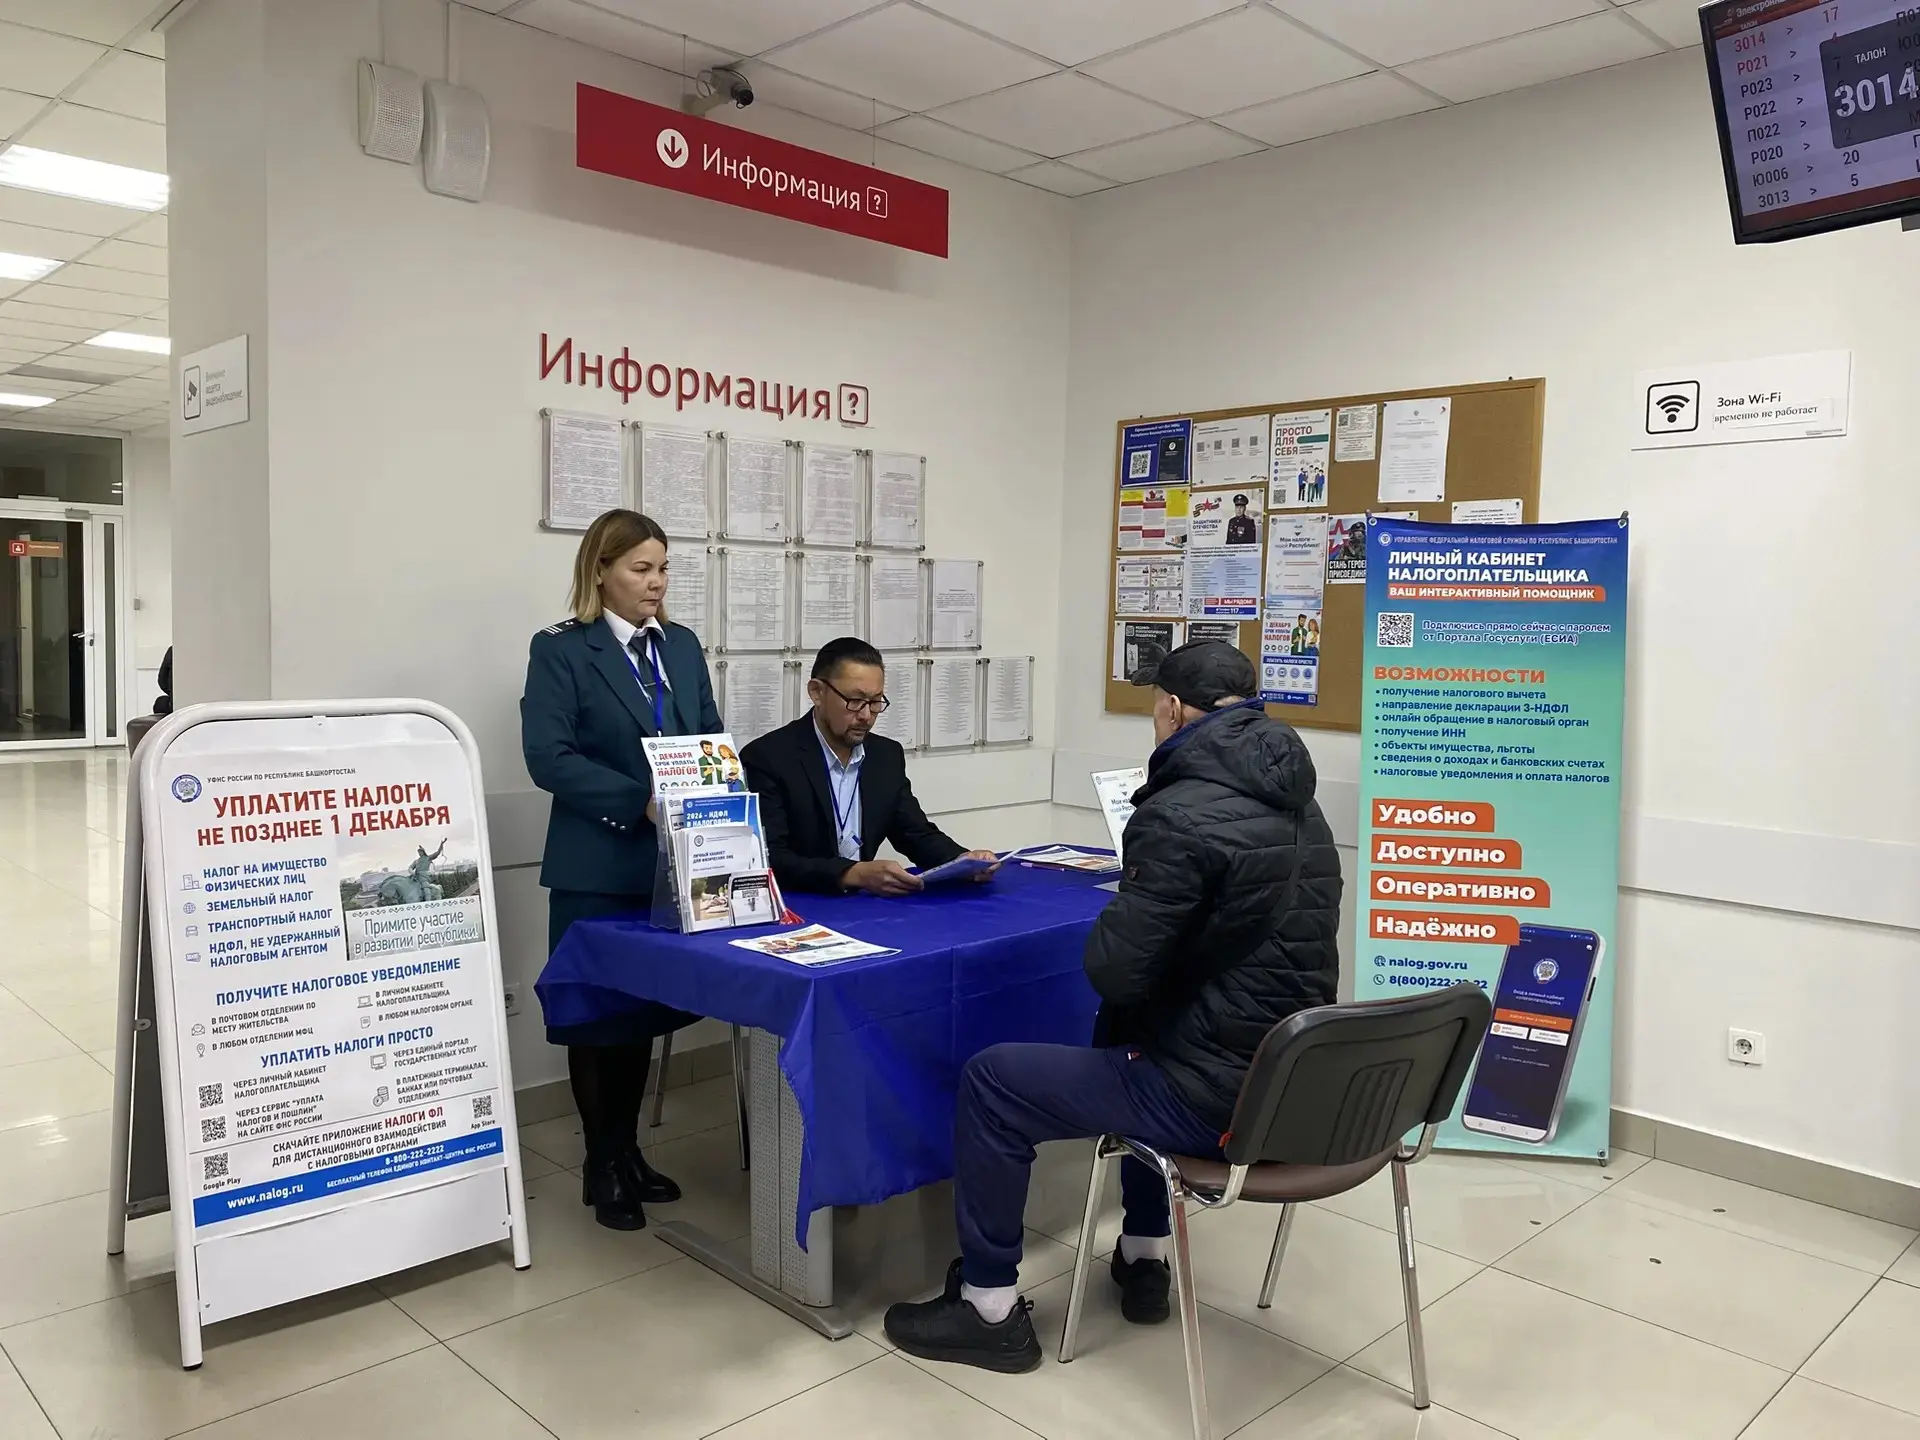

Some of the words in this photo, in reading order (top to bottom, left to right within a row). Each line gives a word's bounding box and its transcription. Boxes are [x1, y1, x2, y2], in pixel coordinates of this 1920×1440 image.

[1823, 7, 1839, 23] 17
[1855, 47, 1886, 64] ТАЛОН
[1835, 66, 1919, 118] 3014
[1748, 123, 1780, 142] П022
[1843, 150, 1860, 165] 20
[703, 143, 861, 211] Информация
[1753, 167, 1788, 187] Ю006
[1851, 174, 1859, 186] 5
[539, 332, 830, 421] Информация
[1717, 397, 1744, 407] Зона
[1748, 392, 1781, 405] Wi-Fi
[1715, 412, 1759, 423] временно
[1775, 406, 1818, 418] работает
[1276, 426, 1312, 437] ПРОСТО
[1275, 437, 1294, 447] ДЛЯ
[1275, 447, 1298, 456] СЕБЯ
[1329, 560, 1347, 568] СТАНЬ
[1388, 549, 1462, 565] ЛИЧНЫЙ
[1466, 550, 1545, 566] КАБИНЕТ
[1388, 568, 1588, 584] НАЛОГОПЛАТЕЛЬЩИКА
[1389, 587, 1416, 597] ВАШ
[1418, 587, 1520, 598] ИНТЕРАКТИВНЫЙ
[1522, 588, 1594, 600] ПОМОЩНИК
[1422, 620, 1485, 632] Подключись
[1485, 621, 1519, 632] прямо
[1519, 621, 1557, 633] сейчас
[1557, 622, 1565, 633] с
[1565, 622, 1611, 633] паролем
[1422, 632, 1434, 643] от
[1434, 632, 1482, 643] Портала
[1482, 633, 1539, 644] Госуслуги
[1539, 633, 1579, 645] (ЕСИА)
[1374, 667, 1544, 682] ВОЗМОЖНОСТИ
[1382, 688, 1439, 697] получение
[1442, 690, 1504, 698] налогового
[1381, 728, 1438, 737] получение
[1441, 728, 1465, 737] ИНН
[659, 752, 692, 760] ДЕКАБРЯ
[1381, 740, 1427, 750] объекты
[1429, 744, 1493, 753] имущества,
[1497, 746, 1534, 754] льготы
[264, 771, 304, 779] РЕСПУБЛИКЕ
[305, 768, 355, 776] БАШКОРТОСТАН
[214, 789, 336, 818] УПЛАТИТЕ
[344, 782, 431, 808] НАЛОГИ
[1379, 804, 1477, 826] Удобно
[198, 827, 224, 846] НЕ
[231, 818, 322, 843] ПОЗДНЕЕ
[331, 814, 339, 834] 1
[349, 804, 449, 833] ДЕКАБРЯ
[1377, 841, 1506, 865] Доступно
[203, 865, 239, 878] НАЛОГ
[243, 863, 258, 874] НА
[262, 857, 326, 872] ИМУЩЕСТВО
[205, 876, 279, 892] ФИЗИЧЕСКИХ
[283, 873, 305, 884] ЛИЦ
[1376, 876, 1536, 902] Оперативно
[206, 895, 276, 911] ЗЕМЕЛЬНЫЙ
[279, 891, 313, 903] НАЛОГ
[207, 913, 295, 932] ТРАНСПОРТНЫЙ
[299, 909, 331, 921] НАЛОГ
[365, 917, 417, 938] Примите
[419, 911, 464, 931] участие
[1376, 916, 1497, 939] Надёжно
[209, 939, 246, 954] НДФЛ,
[250, 937, 264, 948] НЕ
[267, 927, 340, 946] УДЕРЖАННЫЙ
[355, 943, 361, 954] в
[364, 935, 413, 956] развитии
[417, 923, 478, 948] республики!
[210, 949, 278, 967] НАЛОГОВЫМ
[281, 943, 327, 957] АГЕНТОМ
[1389, 958, 1467, 970] nalog.gov.ru
[216, 983, 287, 1005] ПОЛУЧИТЕ
[292, 972, 367, 994] НАЛОГОВОЕ
[372, 958, 460, 981] УВЕДОМЛЕНИЕ
[261, 1044, 330, 1068] УПЛАТИТЬ
[334, 1034, 384, 1054] НАЛОГИ
[388, 1026, 432, 1044] ПРОСТО
[273, 1134, 319, 1152] СКАЧАЙТЕ
[322, 1121, 382, 1141] ПРИЛОЖЕНИЕ
[385, 1110, 425, 1128] НАЛОГИ
[428, 1106, 442, 1118] ФЛ
[470, 1122, 480, 1130] App
[385, 1144, 444, 1165] 8-800-222-2222
[203, 1180, 225, 1190] Google
[226, 1176, 240, 1185] Play
[227, 1184, 304, 1209] www.nalog.ru
